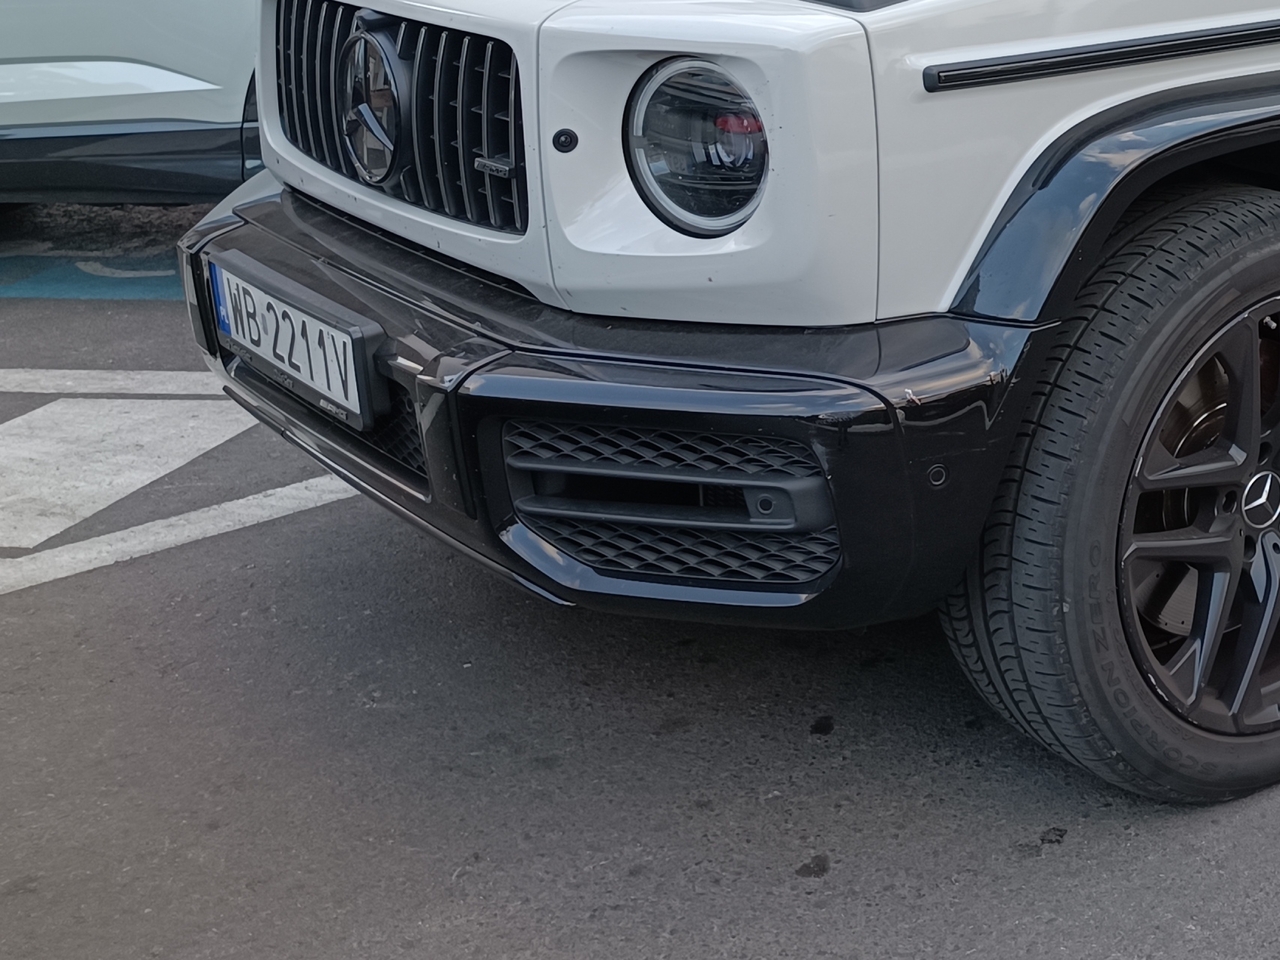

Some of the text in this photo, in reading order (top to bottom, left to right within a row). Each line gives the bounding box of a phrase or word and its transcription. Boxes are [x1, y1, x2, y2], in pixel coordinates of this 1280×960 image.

[227, 277, 349, 402] WB 2211V
[1088, 539, 1219, 776] SCORPION ZERO
